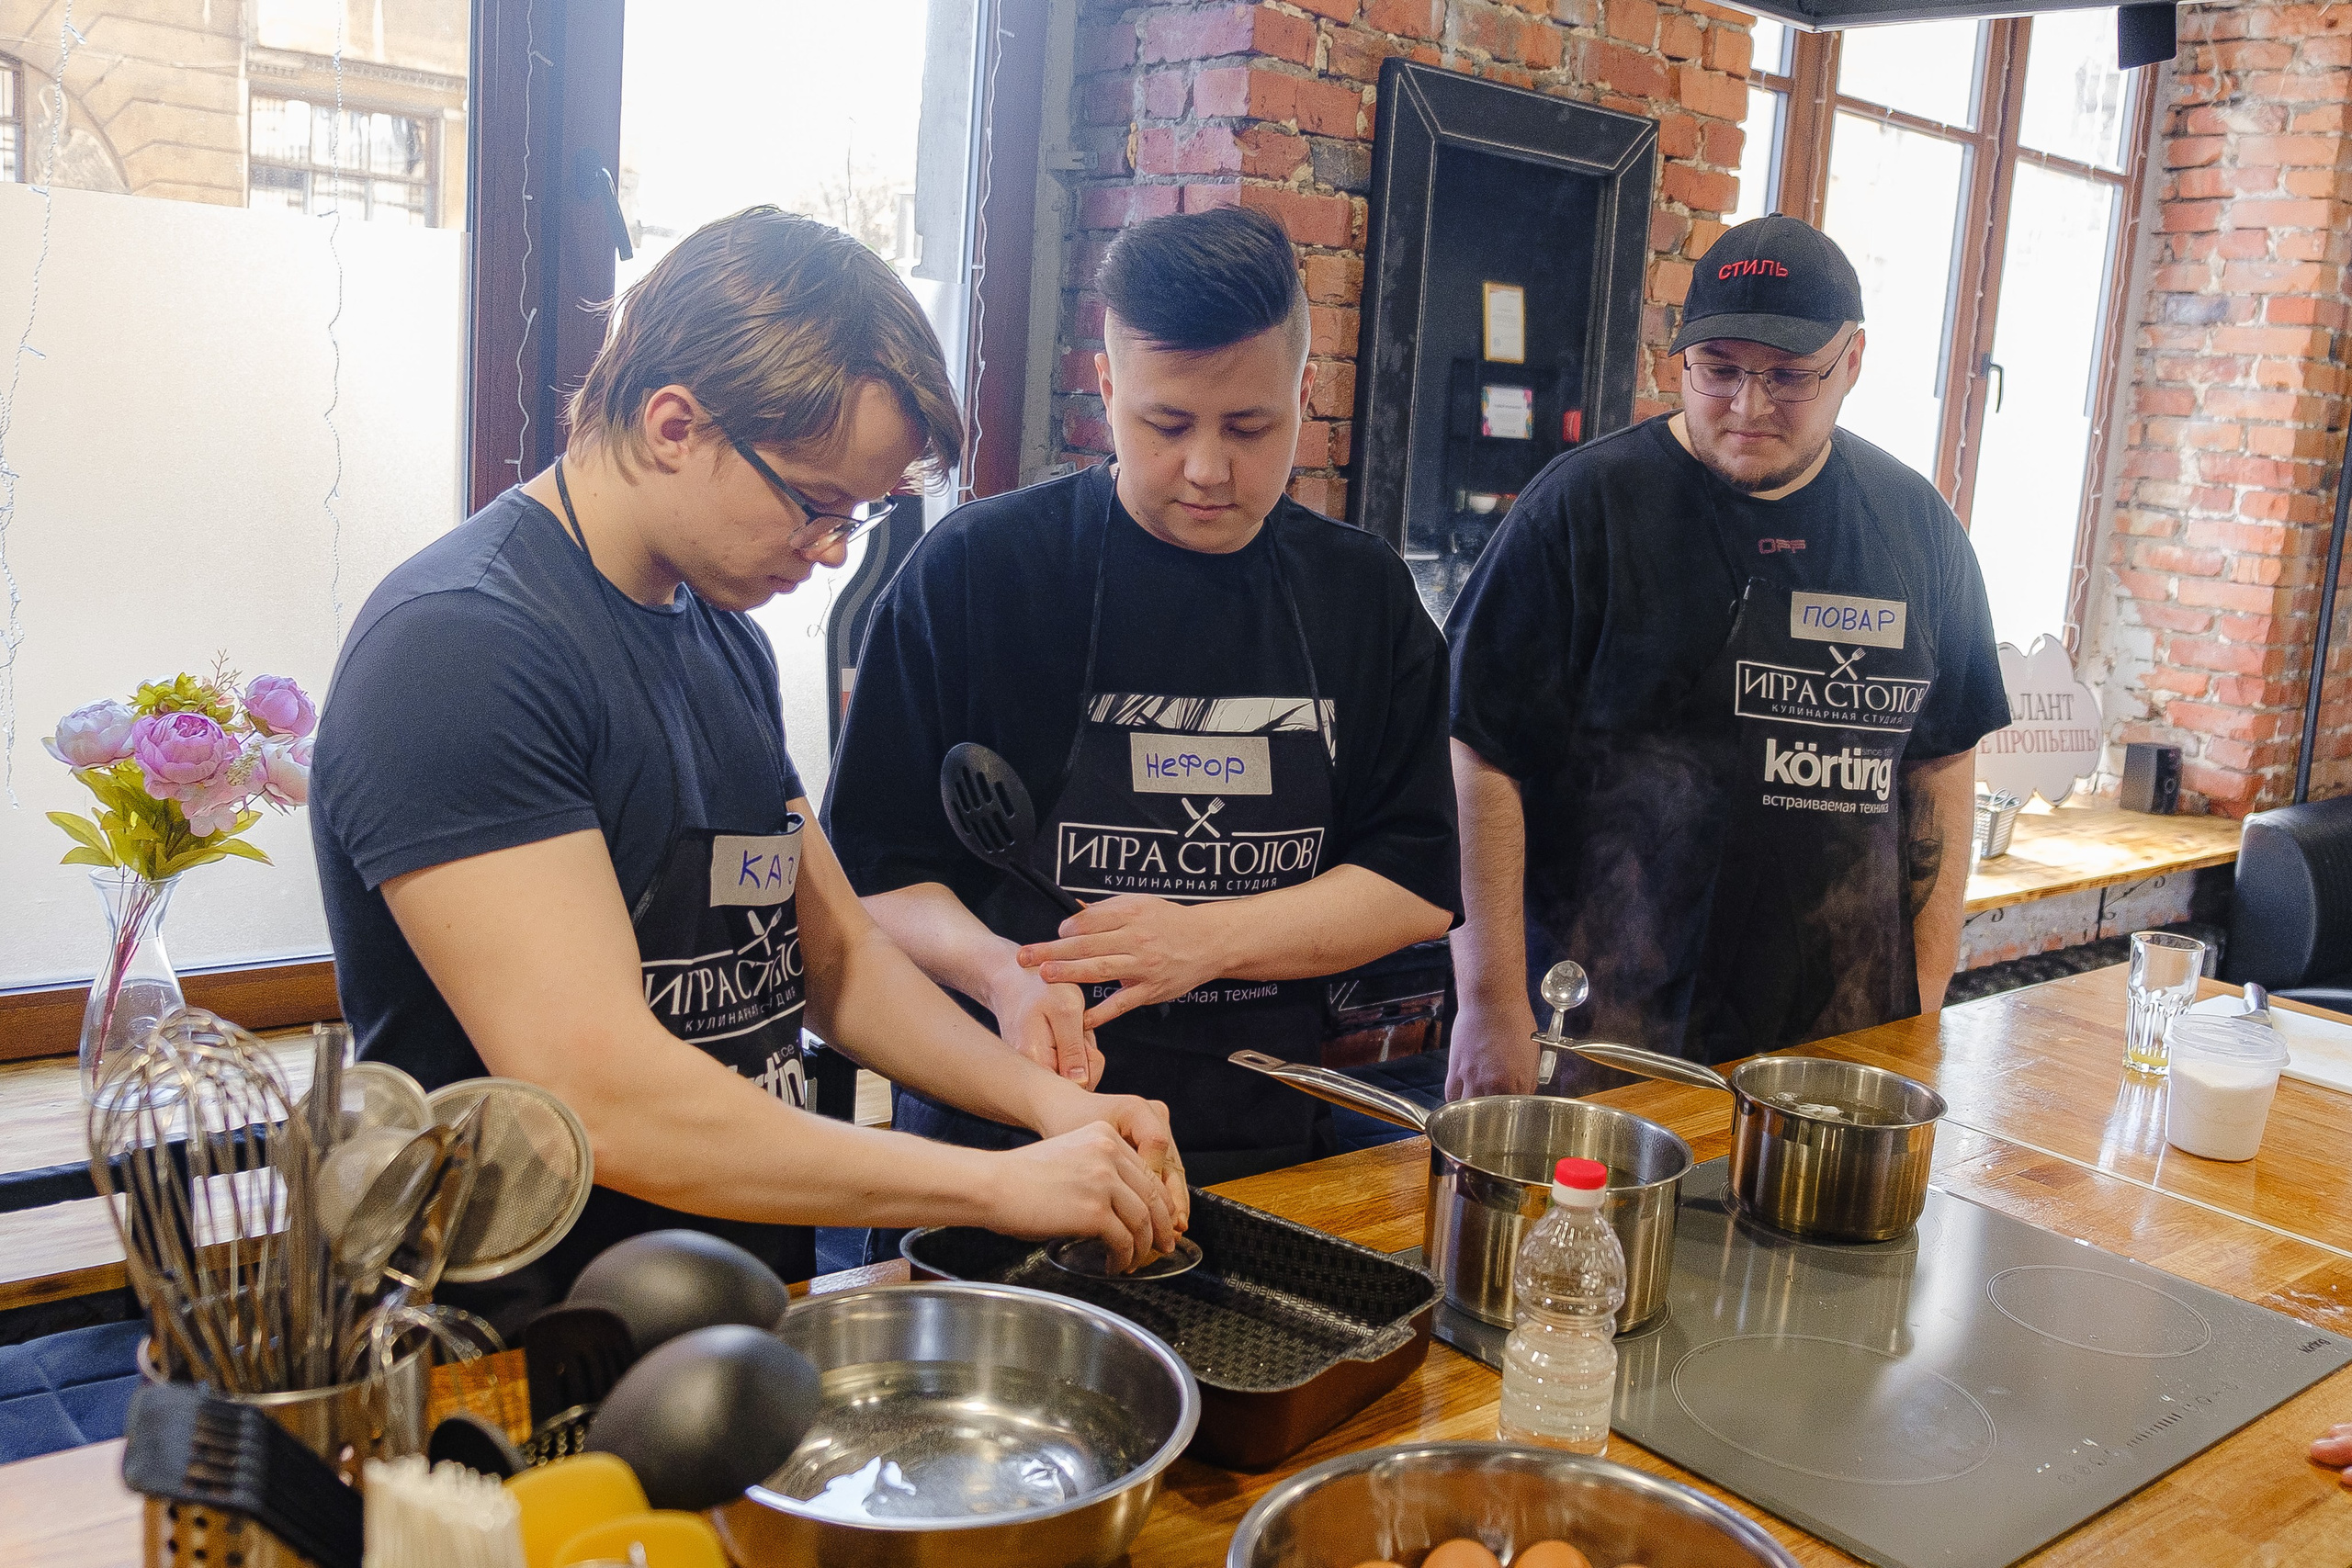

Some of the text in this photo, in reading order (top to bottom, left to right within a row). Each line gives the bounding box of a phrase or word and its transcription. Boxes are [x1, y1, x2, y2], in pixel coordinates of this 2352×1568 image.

[1718, 259, 1789, 280] СТИЛЬ
[1803, 605, 1895, 632] ПОВАР
[1745, 669, 1926, 714] ИГРА СТОЛОВ
[1771, 704, 1903, 725] КУЛИНАРНАЯ СТУДИЯ
[1764, 739, 1893, 800] körting
[1762, 795, 1857, 813] встраиваемая
[1069, 832, 1315, 875] ИГРА СТОЛОВ
[1104, 874, 1278, 890] КУЛИНАРНАЯ СТУДИЯ
[645, 967, 737, 1016] ИГРА
[1224, 983, 1278, 1002] техника
